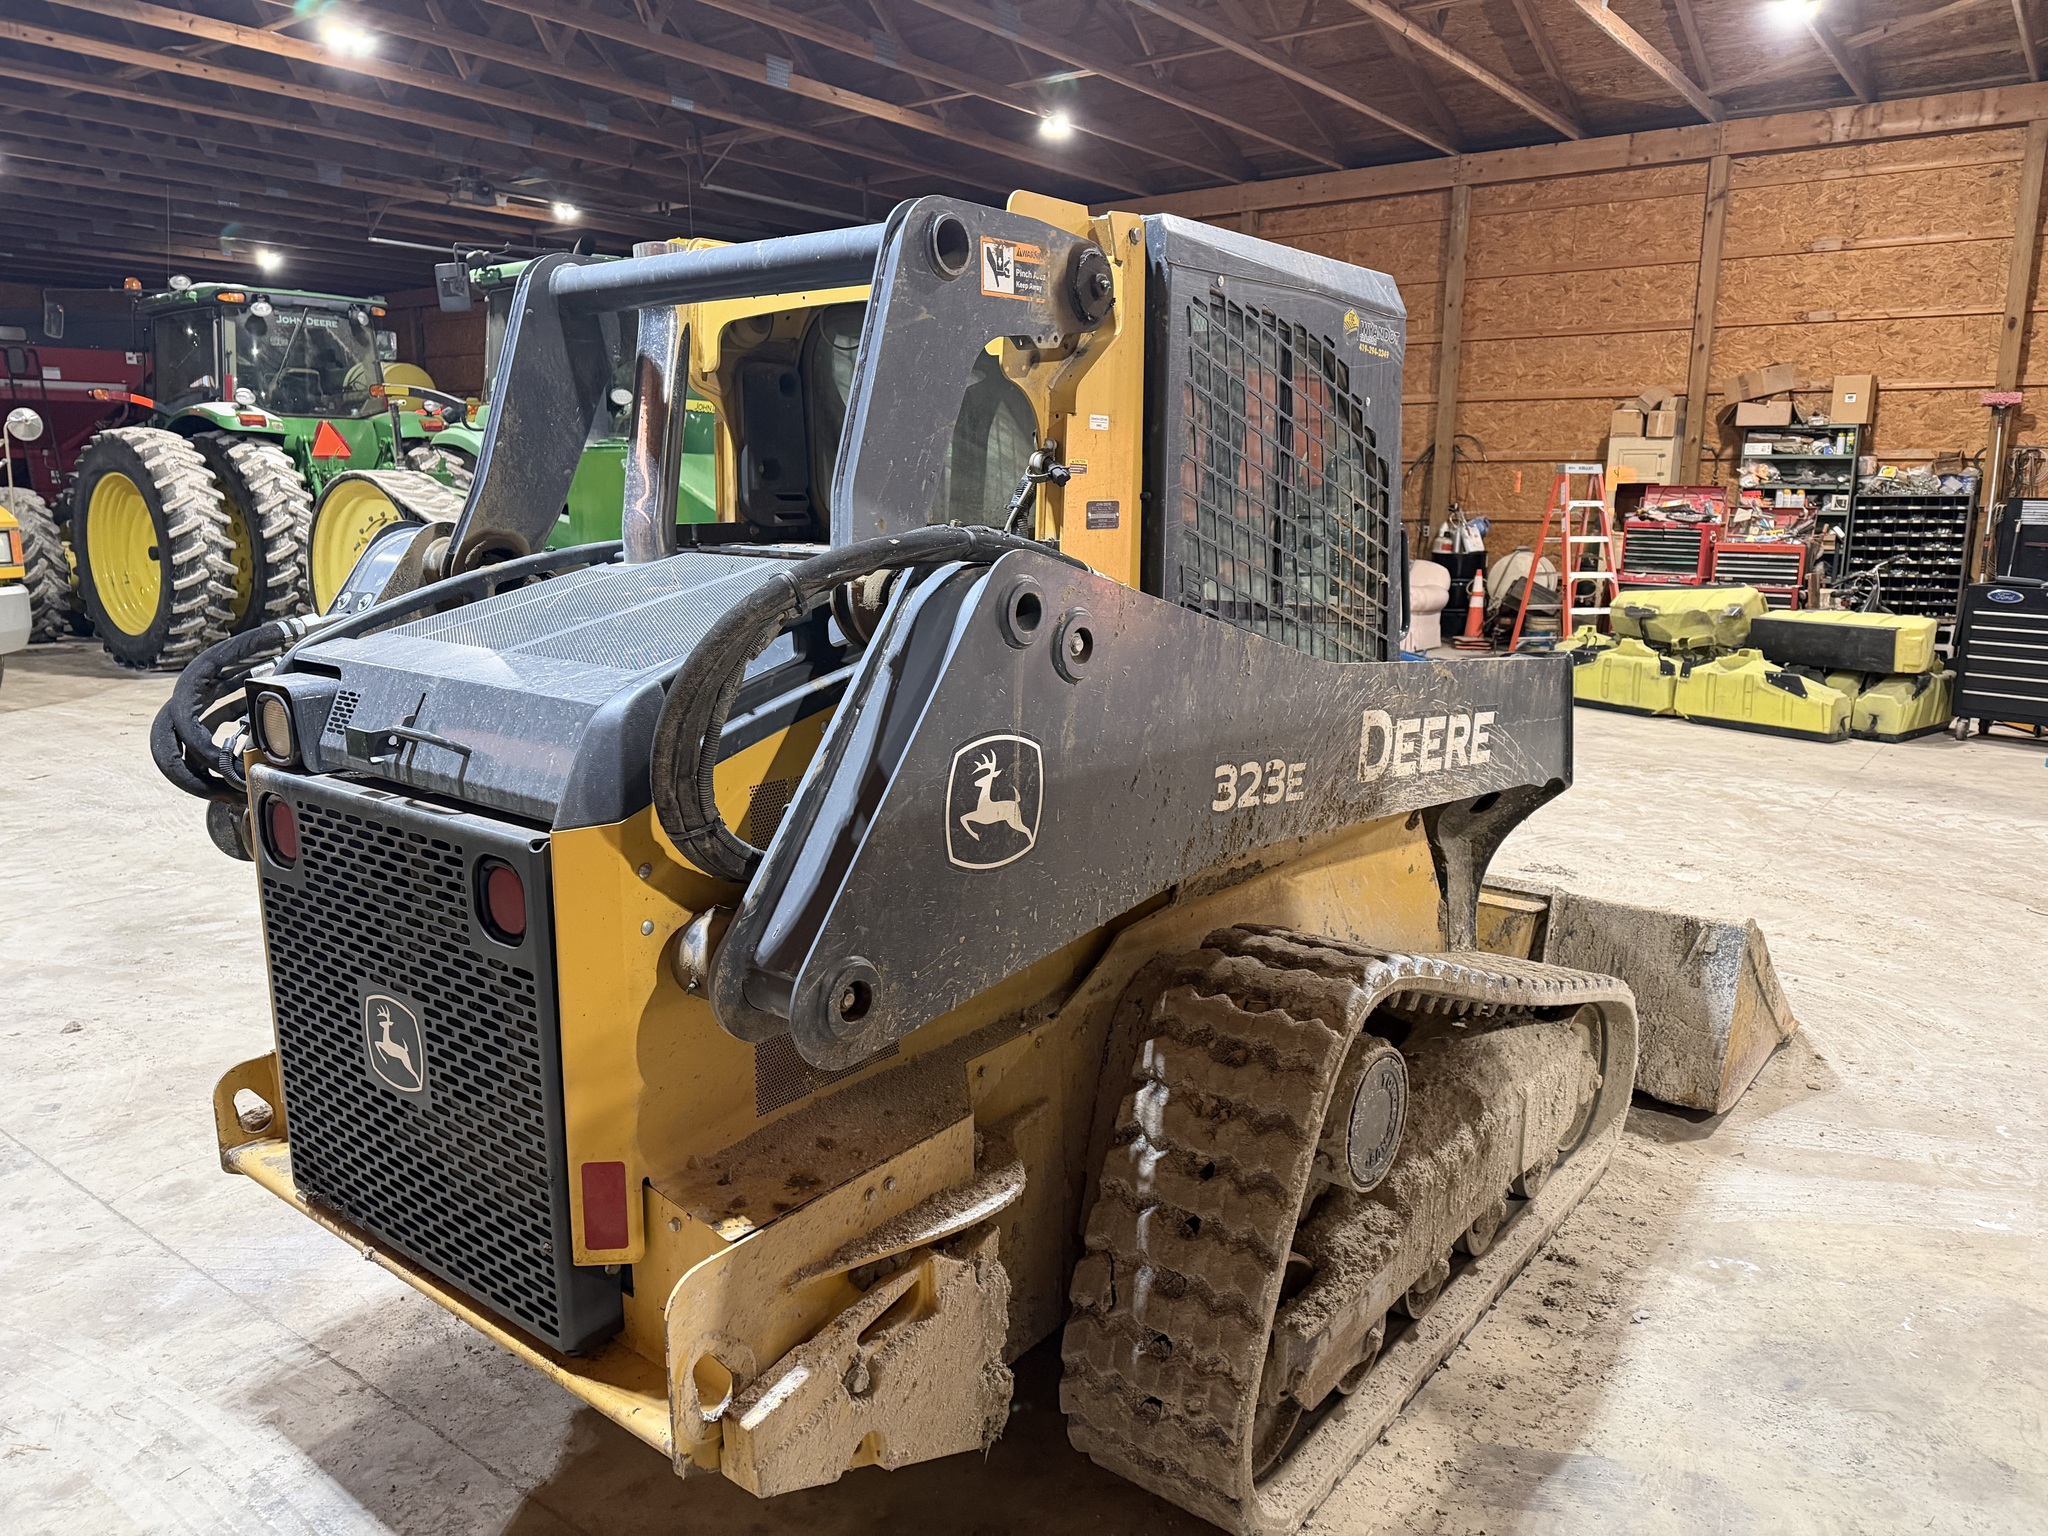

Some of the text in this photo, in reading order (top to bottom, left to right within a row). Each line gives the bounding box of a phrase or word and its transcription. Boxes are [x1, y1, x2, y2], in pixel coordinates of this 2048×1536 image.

[1016, 268, 1032, 278] Pinch
[1016, 280, 1042, 293] Keep Away
[276, 315, 338, 328] JOHN DEERE
[695, 402, 712, 411] JOHN
[1995, 591, 2015, 600] Ford
[1356, 708, 1497, 784] DEERE
[1211, 758, 1307, 812] 323E
